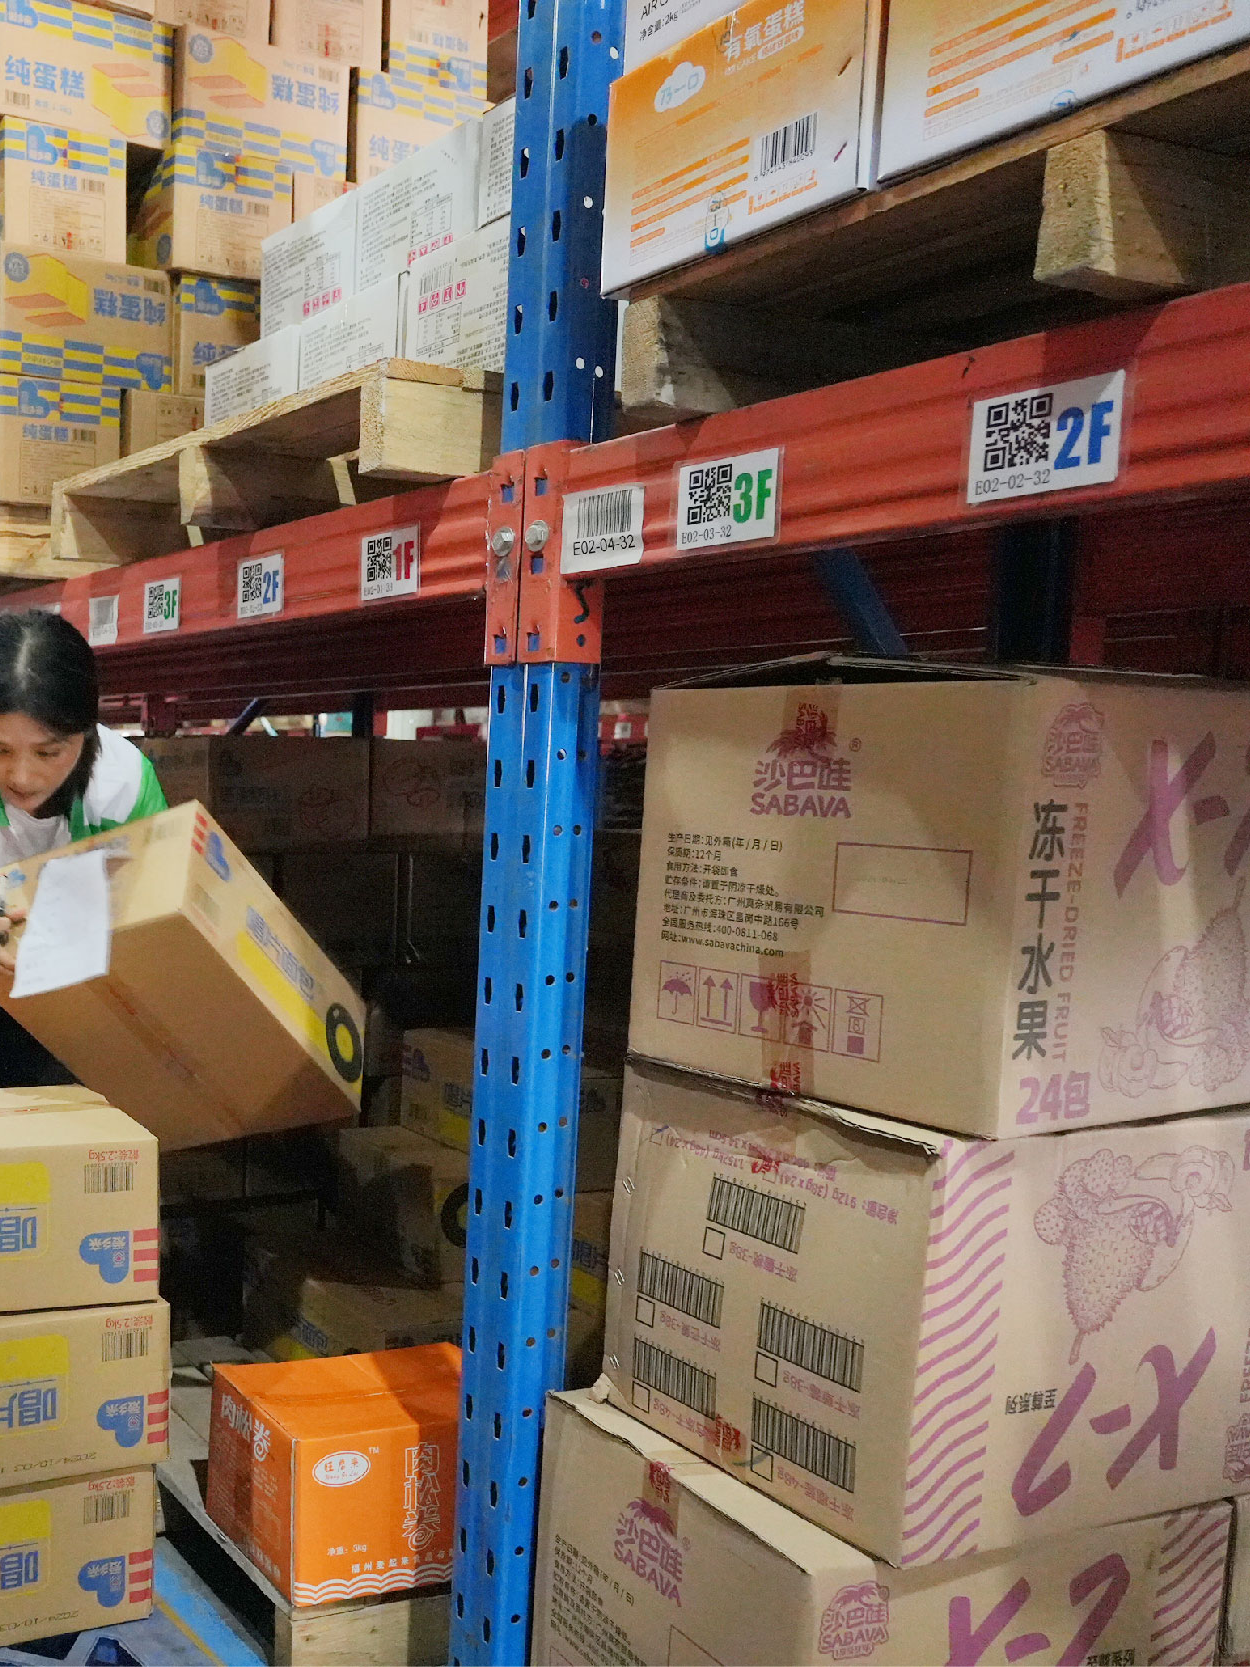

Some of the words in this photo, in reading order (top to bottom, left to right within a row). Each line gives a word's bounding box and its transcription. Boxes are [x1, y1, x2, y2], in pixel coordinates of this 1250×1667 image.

[4, 54, 86, 100] 纯蛋糕
[272, 74, 339, 115] 纯蛋糕
[30, 169, 78, 191] 纯蛋糕
[93, 287, 166, 326] 纯蛋糕
[22, 423, 69, 442] 纯蛋糕
[1054, 401, 1114, 470] 2F
[733, 468, 773, 524] 3F
[975, 468, 1051, 496] E02-02-32
[573, 534, 636, 556] E02-04-32
[681, 524, 732, 545] E02-03-32
[392, 540, 415, 581] 1F
[163, 589, 178, 620] 3F
[262, 569, 280, 605] 2F
[750, 792, 852, 819] SABAVA
[1058, 802, 1089, 982] FREEZE-DRIED
[1012, 799, 1068, 1061] 冻干水果
[1052, 992, 1072, 1063] FRUIT
[1016, 1070, 1091, 1126] 24包
[1005, 1388, 1058, 1415] 至尊系列
[403, 1442, 441, 1551] 肉松卷
[352, 1543, 367, 1554] 3kg
[613, 1538, 682, 1608] SABAVA
[821, 1630, 886, 1649] SABAVA
